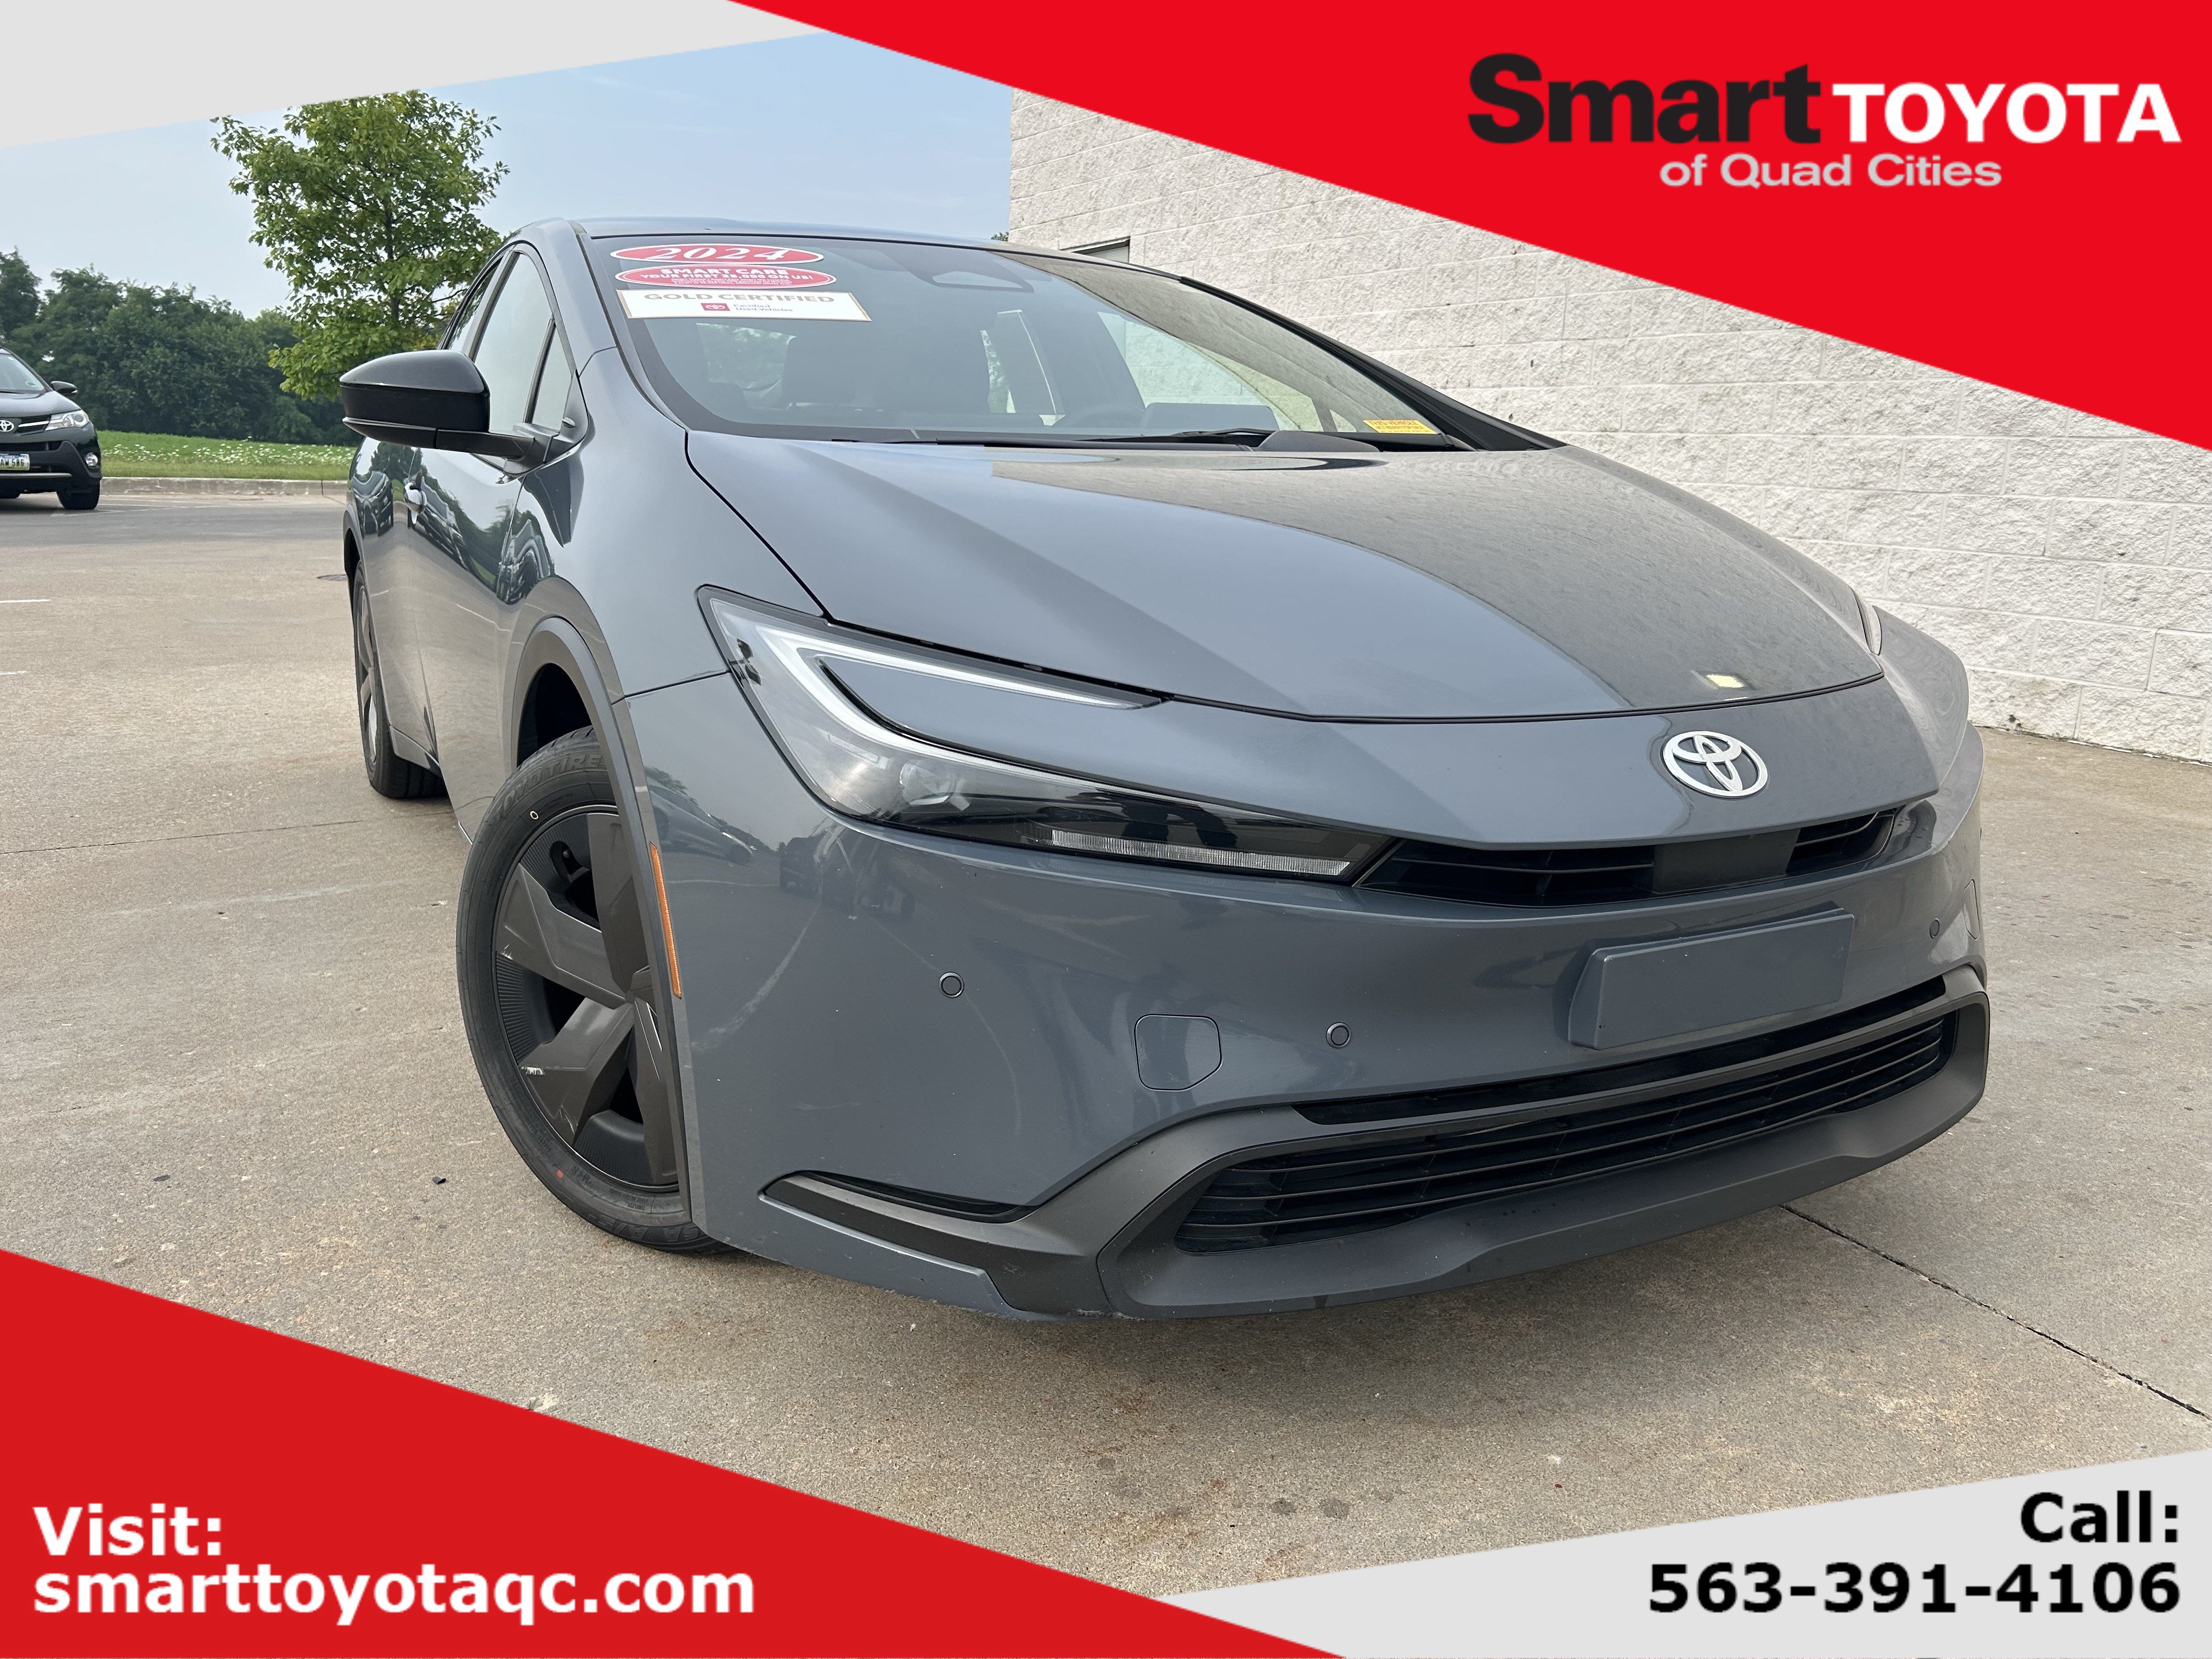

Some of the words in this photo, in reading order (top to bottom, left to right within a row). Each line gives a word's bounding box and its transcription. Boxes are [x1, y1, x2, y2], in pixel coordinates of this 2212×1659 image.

[646, 247, 788, 261] 2024
[718, 294, 835, 303] CERTIFIED
[545, 752, 606, 778] TIRE
